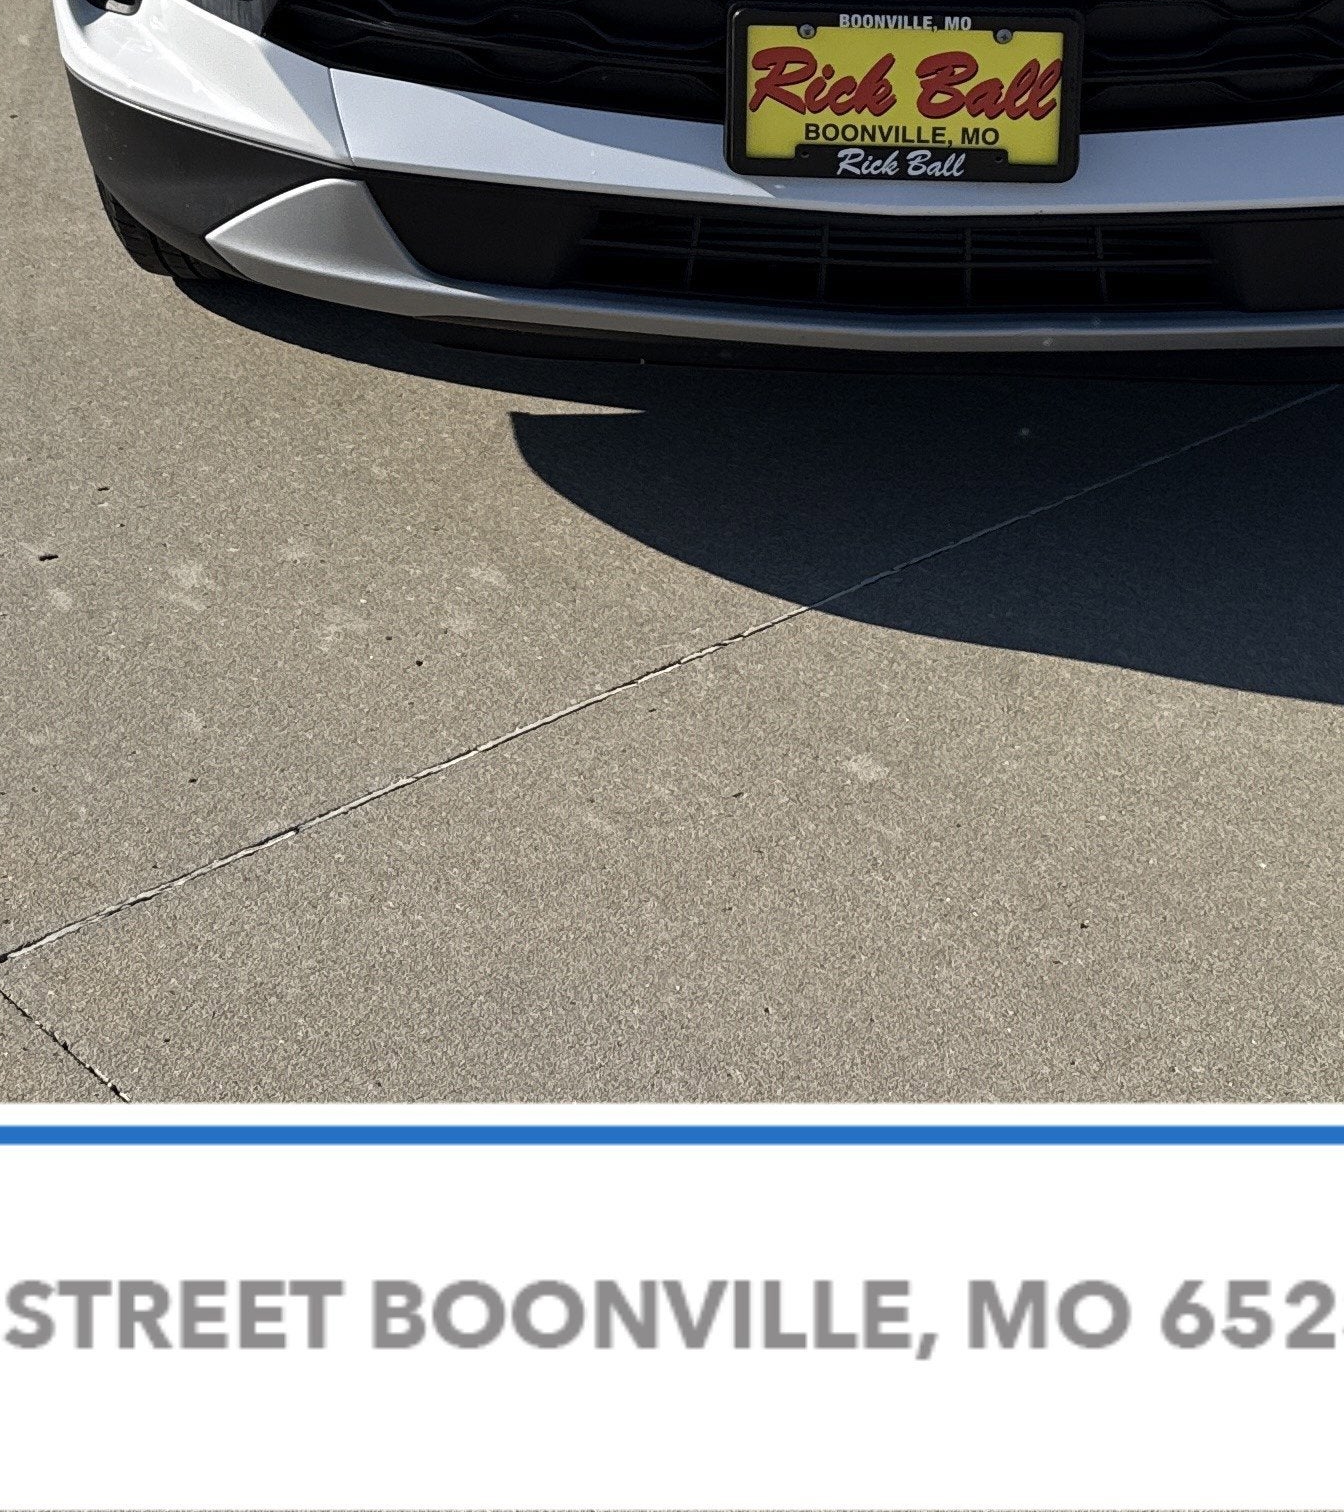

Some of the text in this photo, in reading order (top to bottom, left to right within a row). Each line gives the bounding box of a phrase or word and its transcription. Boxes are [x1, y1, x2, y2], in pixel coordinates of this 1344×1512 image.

[838, 13, 972, 32] BOONVILLE, MO
[748, 46, 1062, 121] Rick Ball
[803, 122, 1000, 148] BOONVILLE, MO
[836, 148, 966, 178] Rick Ball
